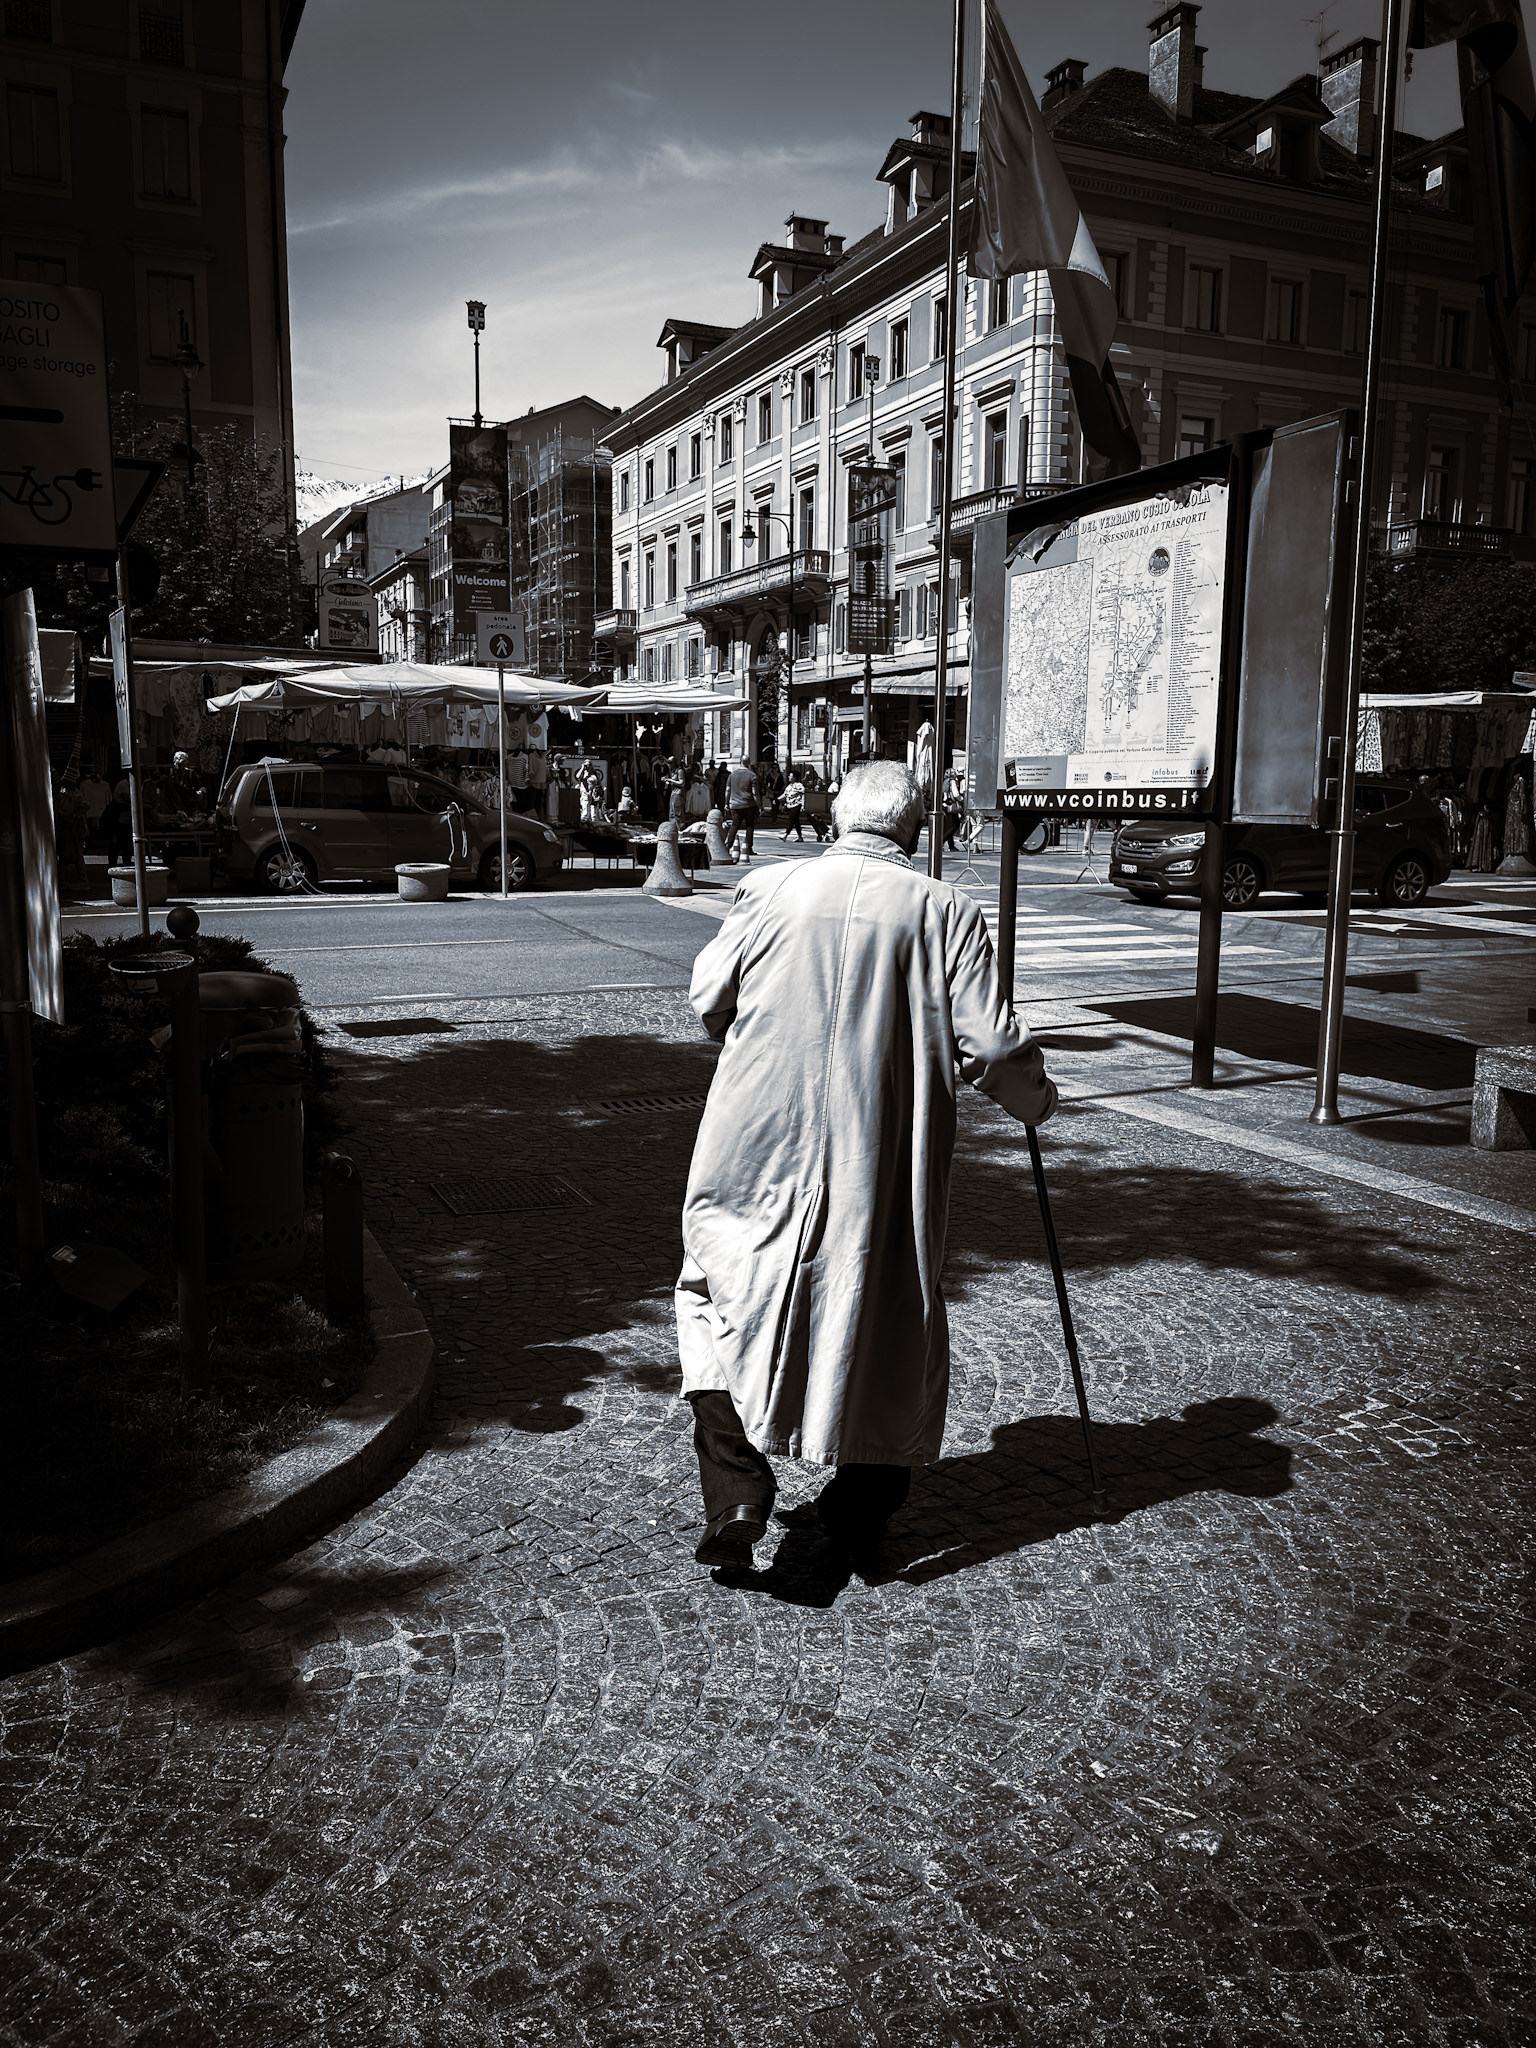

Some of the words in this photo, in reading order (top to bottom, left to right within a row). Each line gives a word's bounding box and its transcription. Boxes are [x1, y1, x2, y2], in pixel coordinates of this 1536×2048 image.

[0, 325, 49, 347] AGLI
[33, 356, 96, 377] storage
[1080, 519, 1098, 535] DEL
[1099, 507, 1142, 530] VERBANO
[1142, 501, 1171, 519] CUSIO
[1097, 527, 1150, 546] ASSESSORATO
[1149, 523, 1161, 533] AI
[1160, 511, 1208, 530] TRASPORTI
[455, 574, 507, 587] Welcome
[1152, 768, 1179, 776] infobus
[1003, 790, 1200, 808] www.vcoinbus.it
